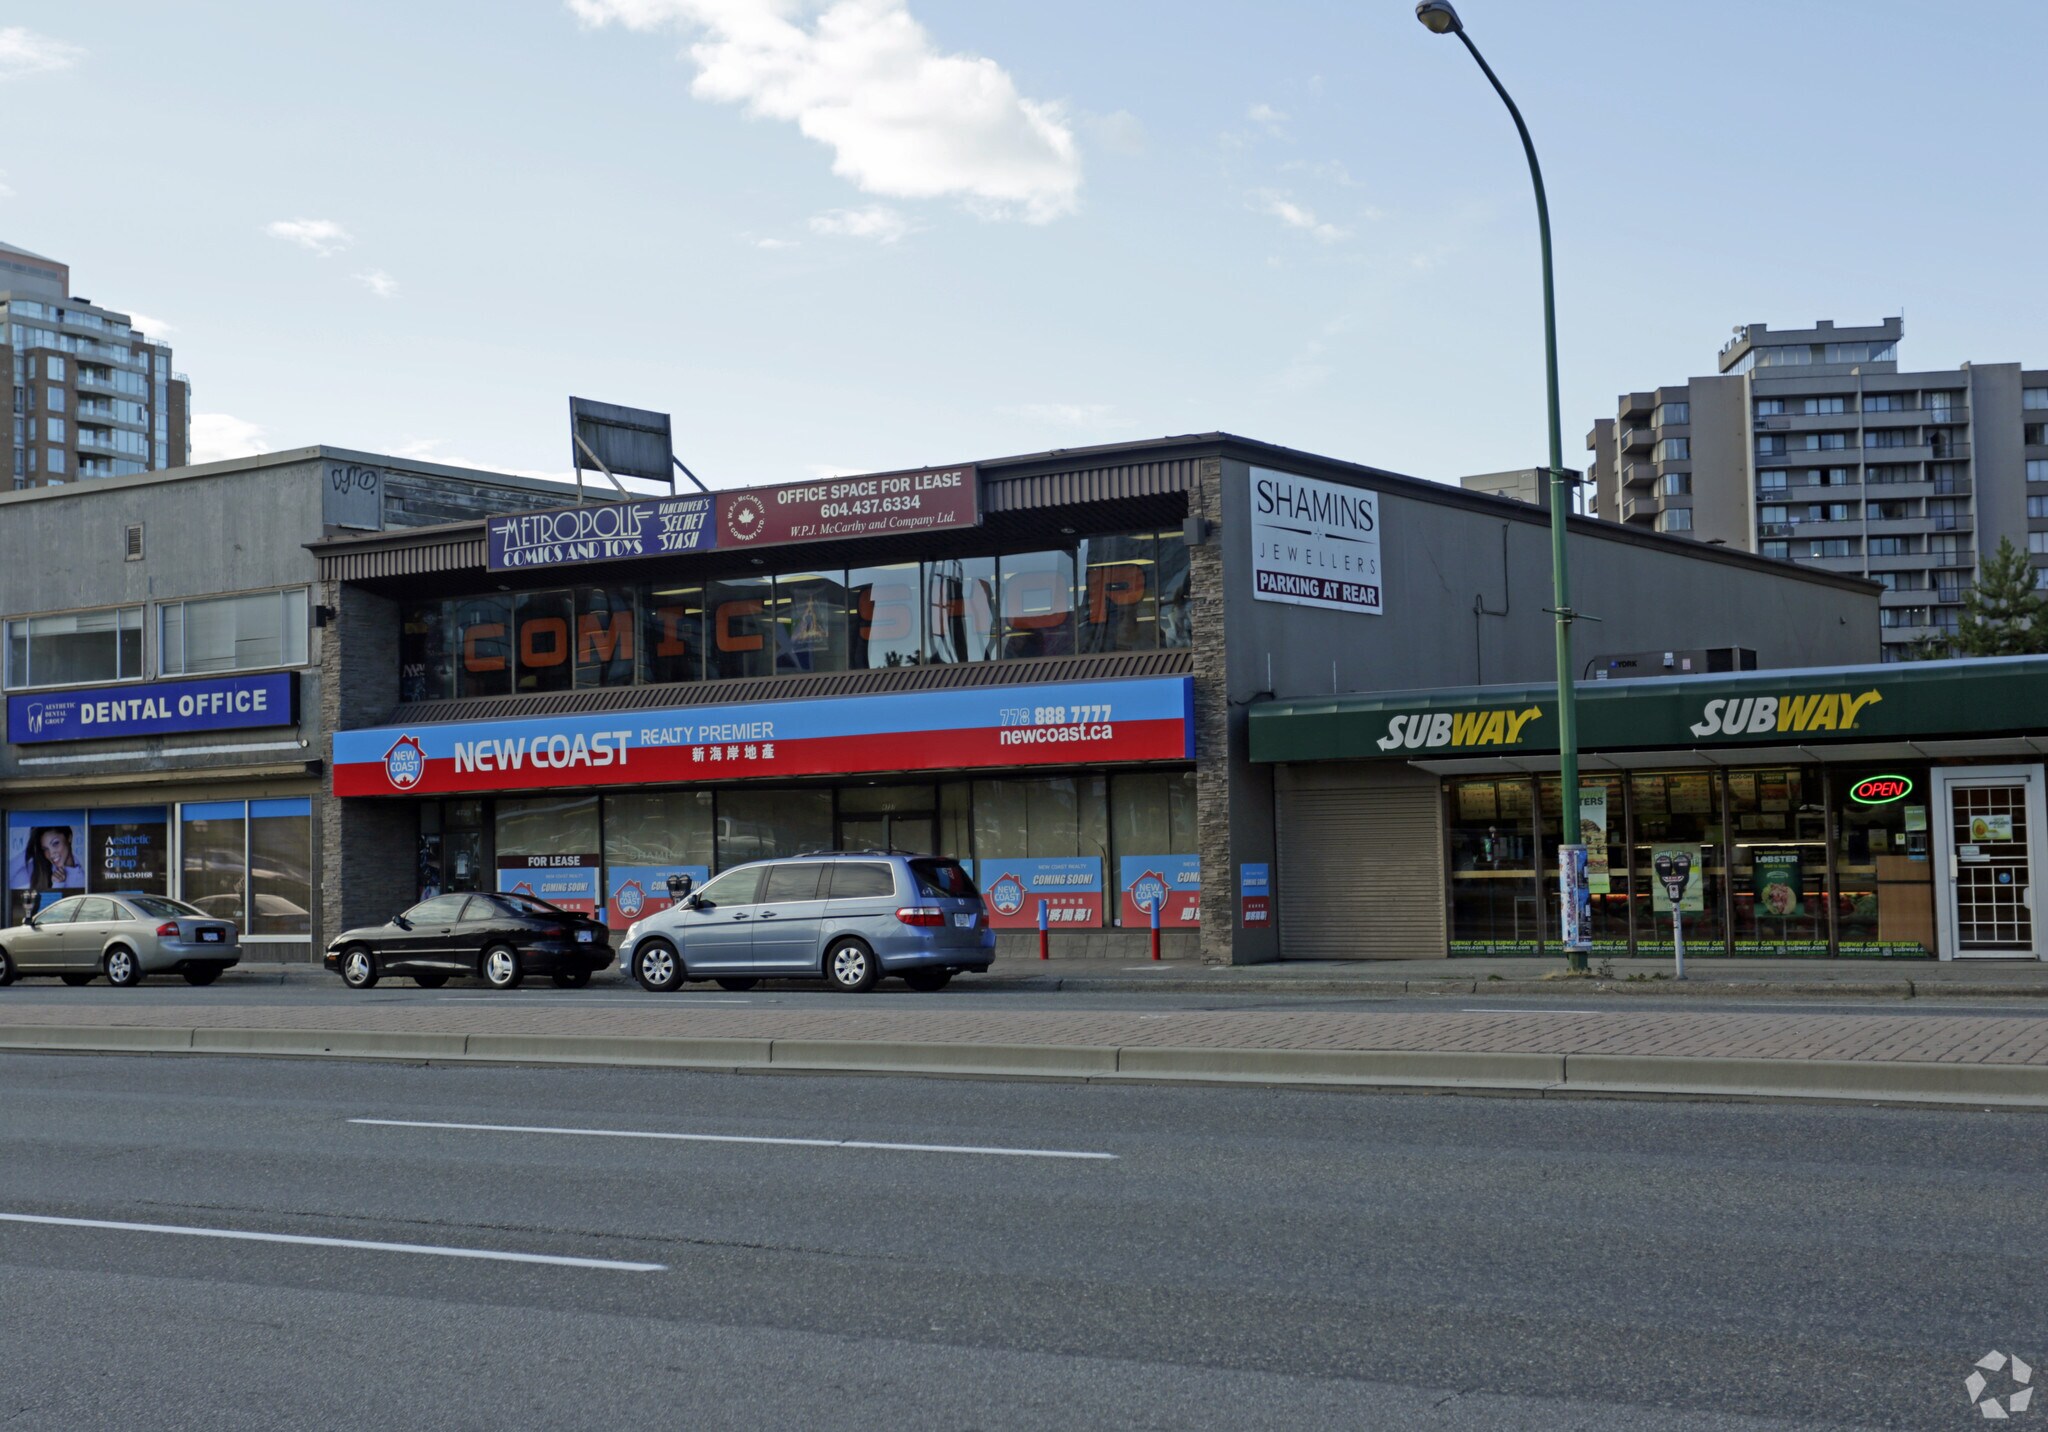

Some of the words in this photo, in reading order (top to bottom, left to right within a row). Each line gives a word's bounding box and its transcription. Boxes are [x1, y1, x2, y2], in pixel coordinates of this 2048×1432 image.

[777, 486, 827, 505] OFFICE
[830, 481, 878, 499] SPACE
[881, 478, 911, 494] FOR
[915, 472, 962, 490] LEASE
[659, 499, 710, 515] VANCOUVER'S
[820, 494, 921, 518] 604.437.6334
[1257, 479, 1374, 532] SHAMINS
[492, 505, 653, 551] METROPOLIS
[659, 512, 708, 532] SECRET
[790, 524, 817, 537] W.P.J.
[820, 520, 867, 534] McCarthy
[868, 517, 888, 530] and
[889, 515, 935, 529] Company
[937, 510, 956, 523] Ltd.
[657, 531, 700, 551] STASH
[503, 544, 563, 567] COMICS
[565, 541, 600, 561] AND
[603, 539, 643, 558] TOYS
[1260, 542, 1376, 575] JEWELLERS
[1259, 572, 1320, 597] PARKING
[1323, 581, 1340, 600] AT
[1342, 584, 1376, 605] REAR
[463, 599, 764, 673] COMIC
[858, 563, 1147, 641] SHOP
[45, 702, 76, 710] AESTHETIC
[45, 710, 67, 718] DENTAL
[80, 697, 172, 725] DENTAL
[178, 689, 268, 716] OFFICE
[1690, 688, 1883, 739] SUBWAY
[1000, 707, 1030, 727] 778
[1034, 706, 1065, 725] 888
[1071, 704, 1111, 724] 7777
[641, 726, 694, 745] REALTY
[698, 721, 775, 742] PREMIER
[1000, 722, 1113, 745] newcoast.ca
[1376, 705, 1543, 752] SUBWAY
[393, 750, 416, 761] NEW
[454, 737, 526, 773] NEW
[530, 730, 632, 769] COAST
[692, 743, 775, 762] 新海岸地產
[390, 761, 419, 772] COAST
[1858, 781, 1904, 797] OPEN
[1580, 797, 1604, 806] TERS
[105, 834, 151, 846] Aesthetic
[105, 846, 138, 857] Dental
[1755, 855, 1799, 863] LOBSTER
[104, 858, 137, 870] Group
[527, 856, 547, 867] FOR
[549, 855, 581, 867] LEASE
[651, 880, 668, 891] COM
[1032, 874, 1067, 885] COMING
[1066, 873, 1094, 885] SOON!
[1177, 872, 1200, 883] COM
[541, 882, 567, 893] COMING
[567, 881, 590, 892] SOON!
[621, 890, 639, 898] NEW
[997, 885, 1018, 893] NEW
[1139, 883, 1160, 892] NEW
[619, 897, 641, 905] COAST
[994, 893, 1020, 901] COAST
